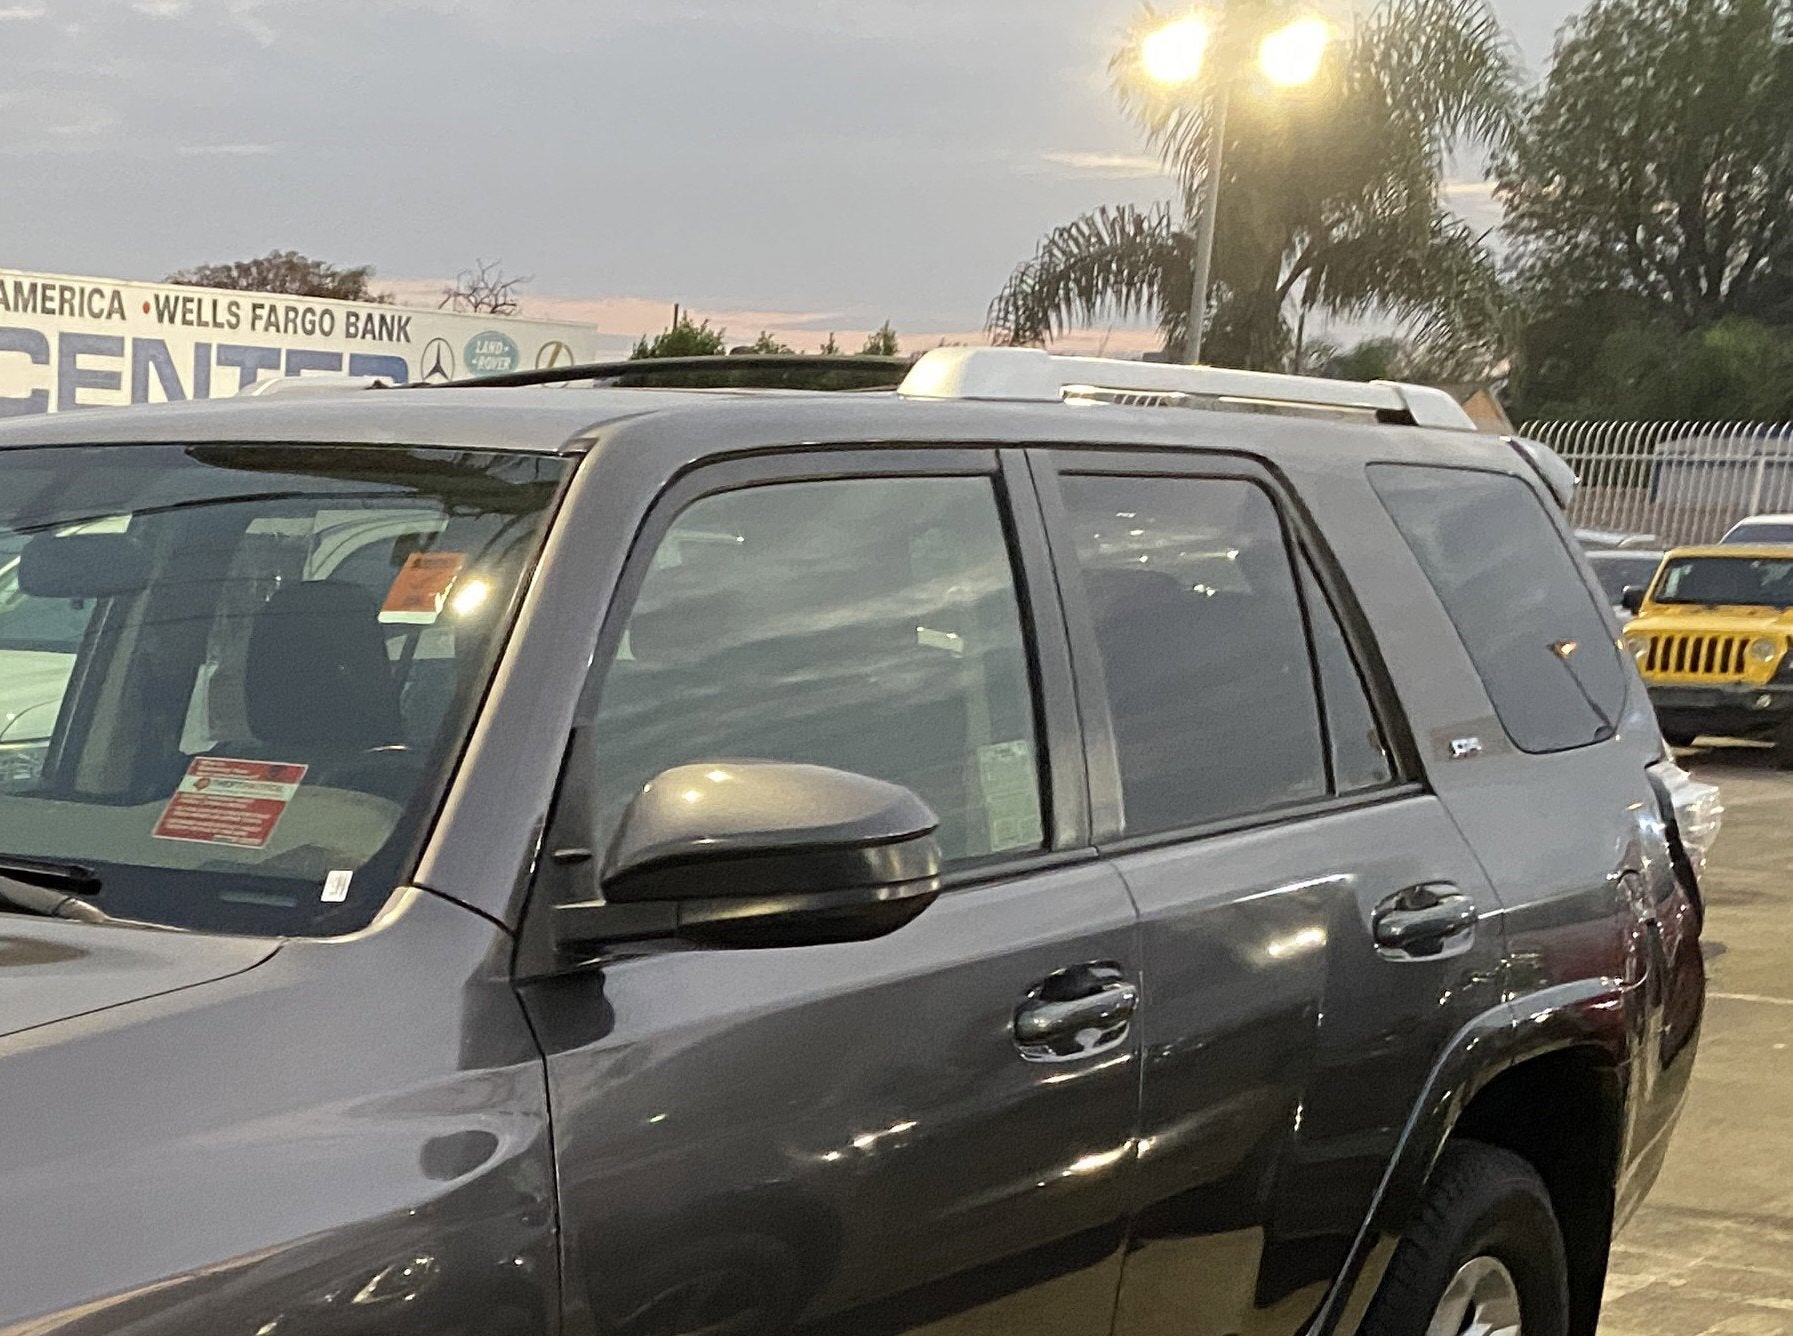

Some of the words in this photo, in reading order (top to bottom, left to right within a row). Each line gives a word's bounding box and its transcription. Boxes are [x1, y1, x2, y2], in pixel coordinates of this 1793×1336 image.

[153, 293, 241, 331] WELLS
[251, 303, 335, 339] FARGO
[345, 310, 412, 344] BANK
